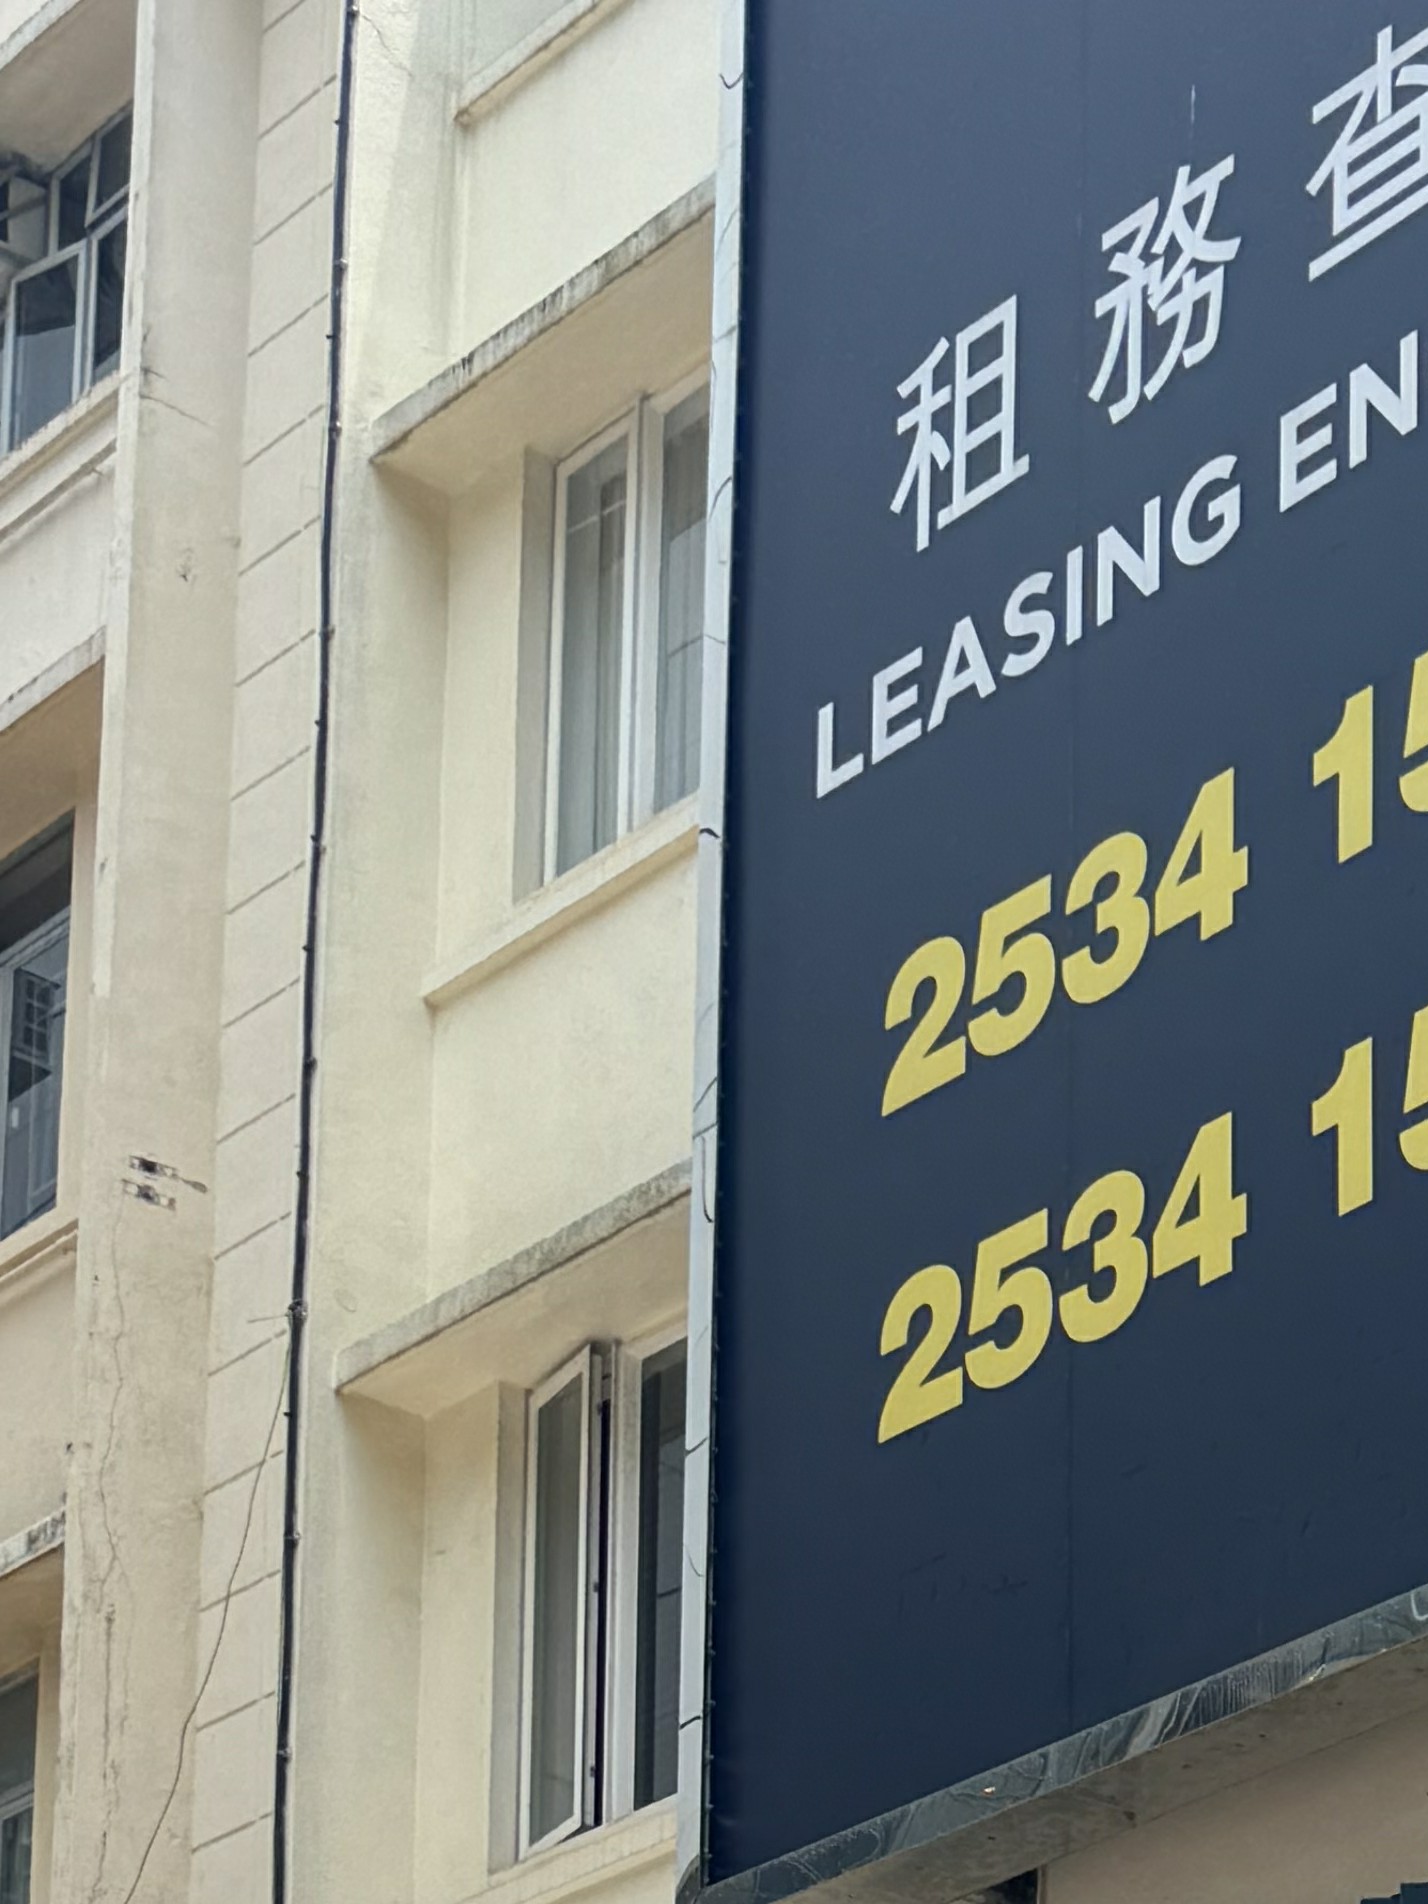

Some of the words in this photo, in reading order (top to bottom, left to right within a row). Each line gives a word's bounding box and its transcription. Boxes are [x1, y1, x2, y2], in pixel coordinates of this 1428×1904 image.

[817, 455, 1240, 798] LEASING
[882, 772, 1246, 1114] 2534
[879, 1114, 1245, 1441] 2534
